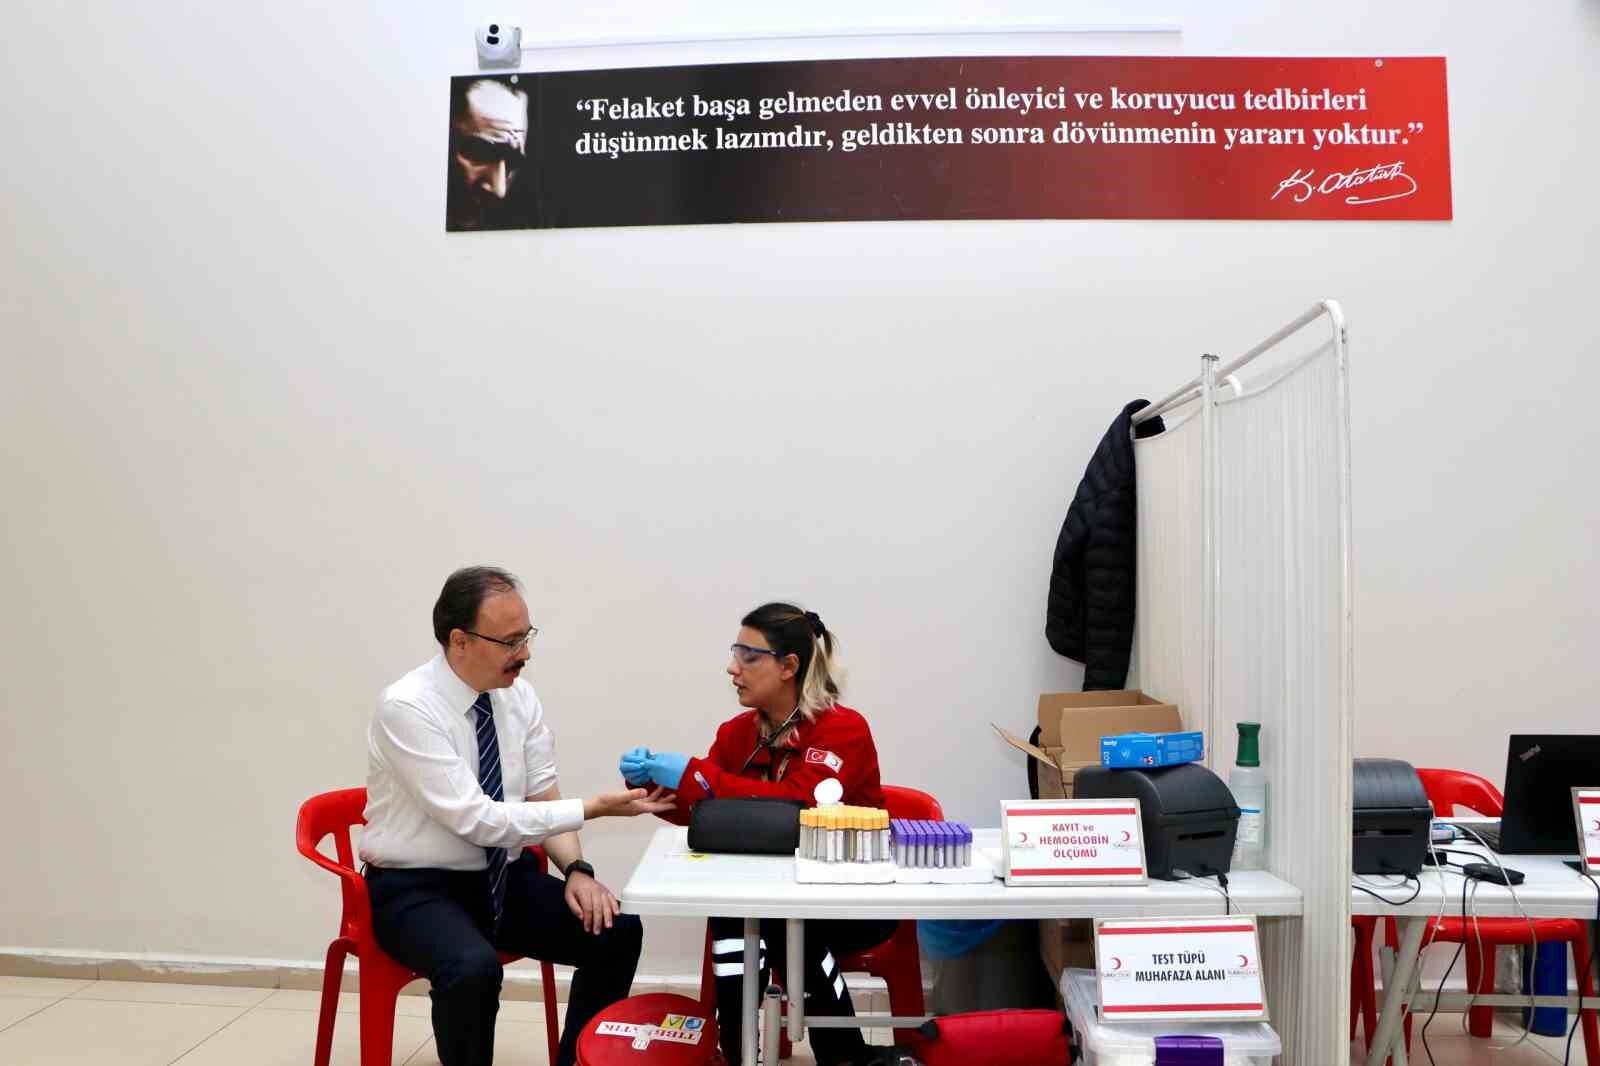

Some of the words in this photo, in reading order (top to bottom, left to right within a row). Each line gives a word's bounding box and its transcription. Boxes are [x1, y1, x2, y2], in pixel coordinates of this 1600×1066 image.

[575, 96, 686, 121] “Felaket
[693, 94, 751, 122] başa
[759, 90, 883, 121] gelmeden
[890, 87, 958, 111] evvel
[965, 86, 1067, 115] önleyici
[1074, 92, 1103, 110] ve
[1110, 86, 1236, 116] koruyucu
[1243, 87, 1367, 111] tedbirleri
[575, 126, 708, 160] düşünmek
[715, 124, 834, 152] lazımdır,
[841, 122, 964, 152] geldikten
[970, 126, 1045, 144] sonra
[1052, 120, 1217, 144] dövünmenin
[1223, 128, 1305, 150] yararı
[1312, 121, 1424, 151] yoktur.”
[1051, 822, 1080, 832] KAYIT
[1039, 834, 1109, 845] HEMOGLOBİN
[1053, 847, 1097, 860] ÖLÇÜMÜ
[1151, 952, 1174, 965] TEST
[1177, 949, 1206, 965] TÜPÜ
[1135, 968, 1193, 982] MUHAFAZA
[1195, 968, 1226, 981] ALANI
